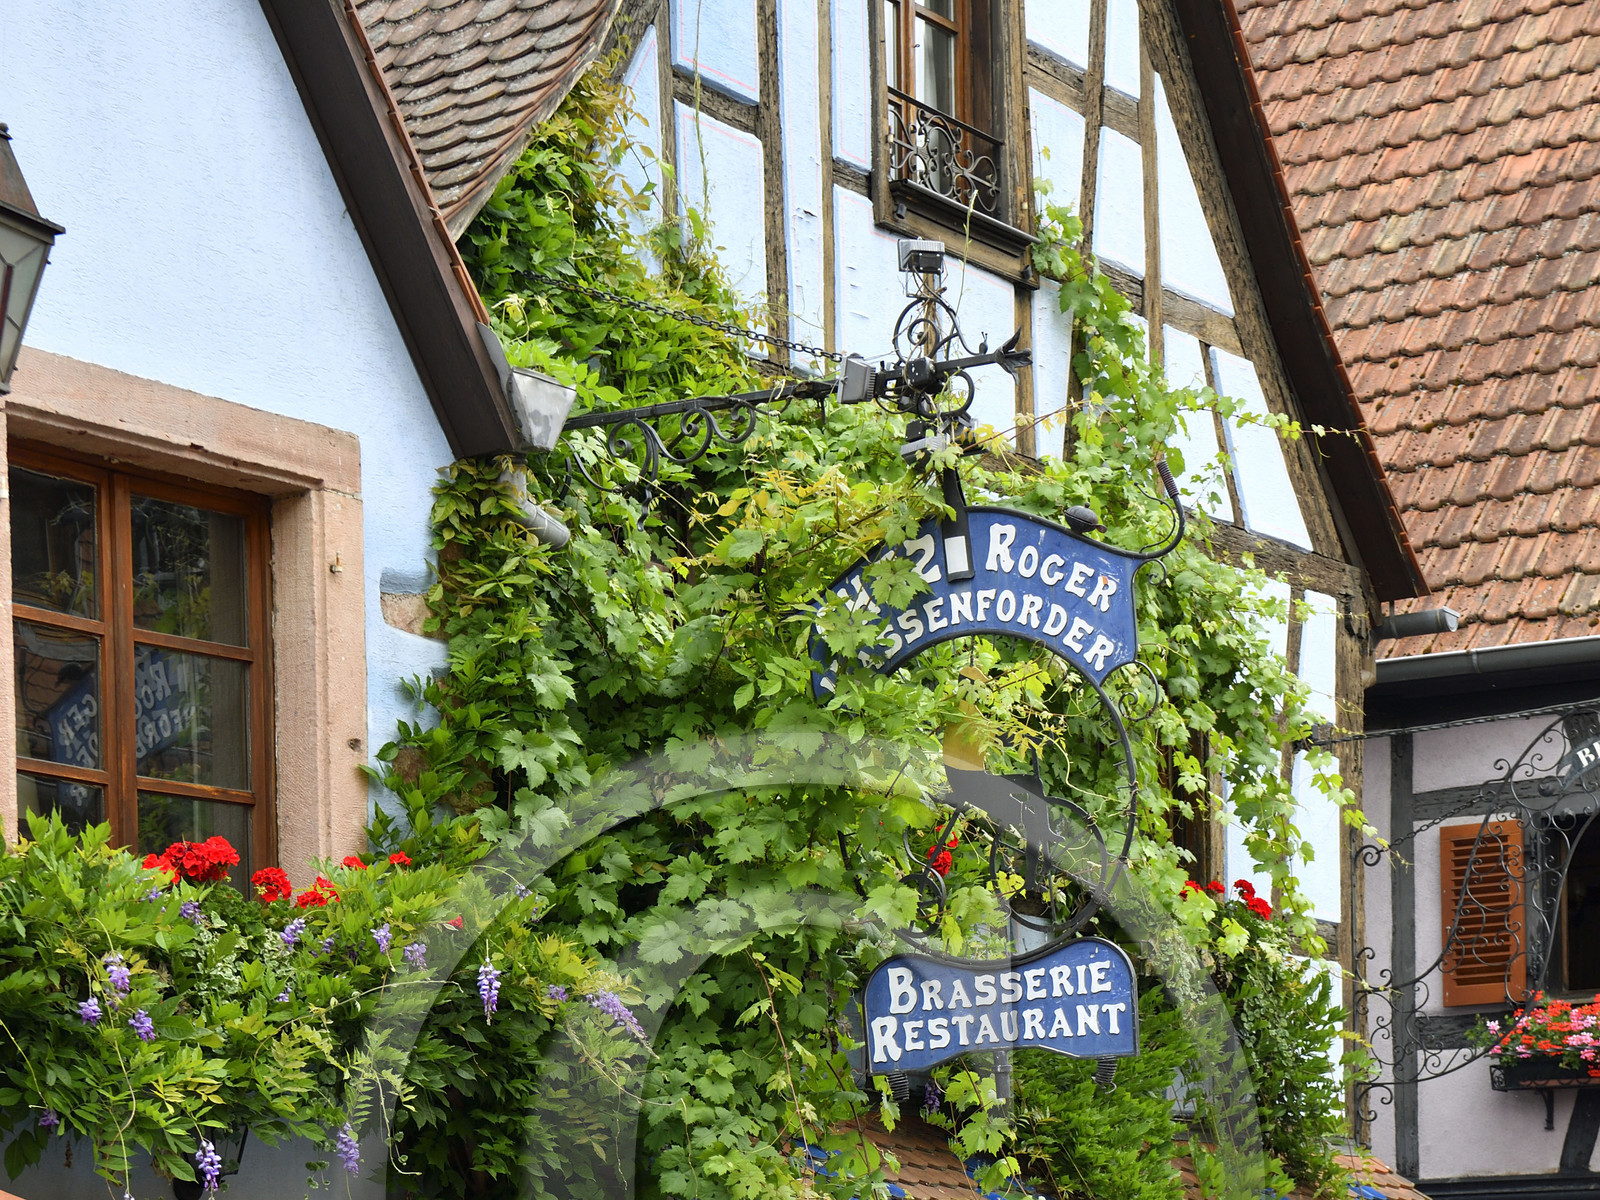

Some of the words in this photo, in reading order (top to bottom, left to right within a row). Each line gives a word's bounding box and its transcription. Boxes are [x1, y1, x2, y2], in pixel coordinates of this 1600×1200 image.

[985, 522, 1118, 612] ROGER
[887, 959, 1112, 1015] BRASSERIE
[870, 1002, 1126, 1063] RESTAURANT
